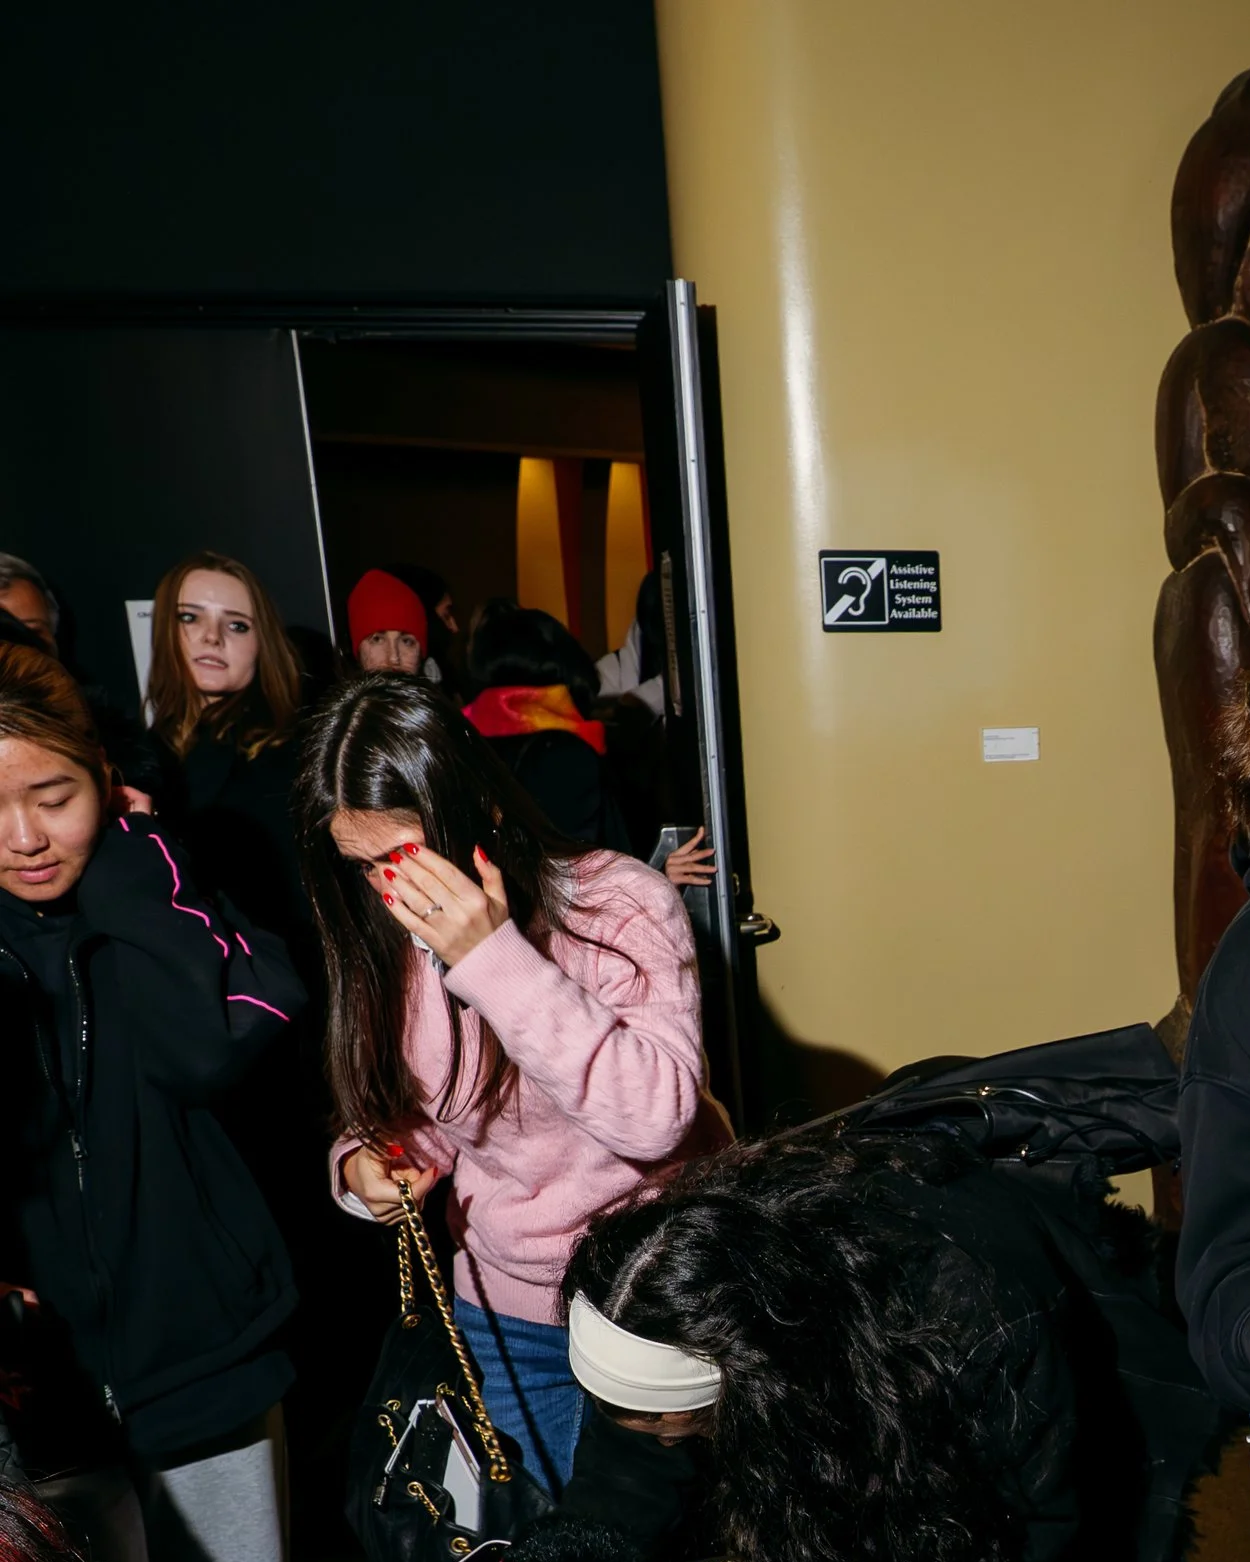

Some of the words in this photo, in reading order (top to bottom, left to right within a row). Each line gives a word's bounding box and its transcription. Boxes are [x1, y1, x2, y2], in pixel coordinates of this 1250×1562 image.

[890, 564, 935, 575] Assistive
[890, 579, 937, 593] Listening
[894, 593, 933, 607] System
[890, 608, 939, 620] Available
